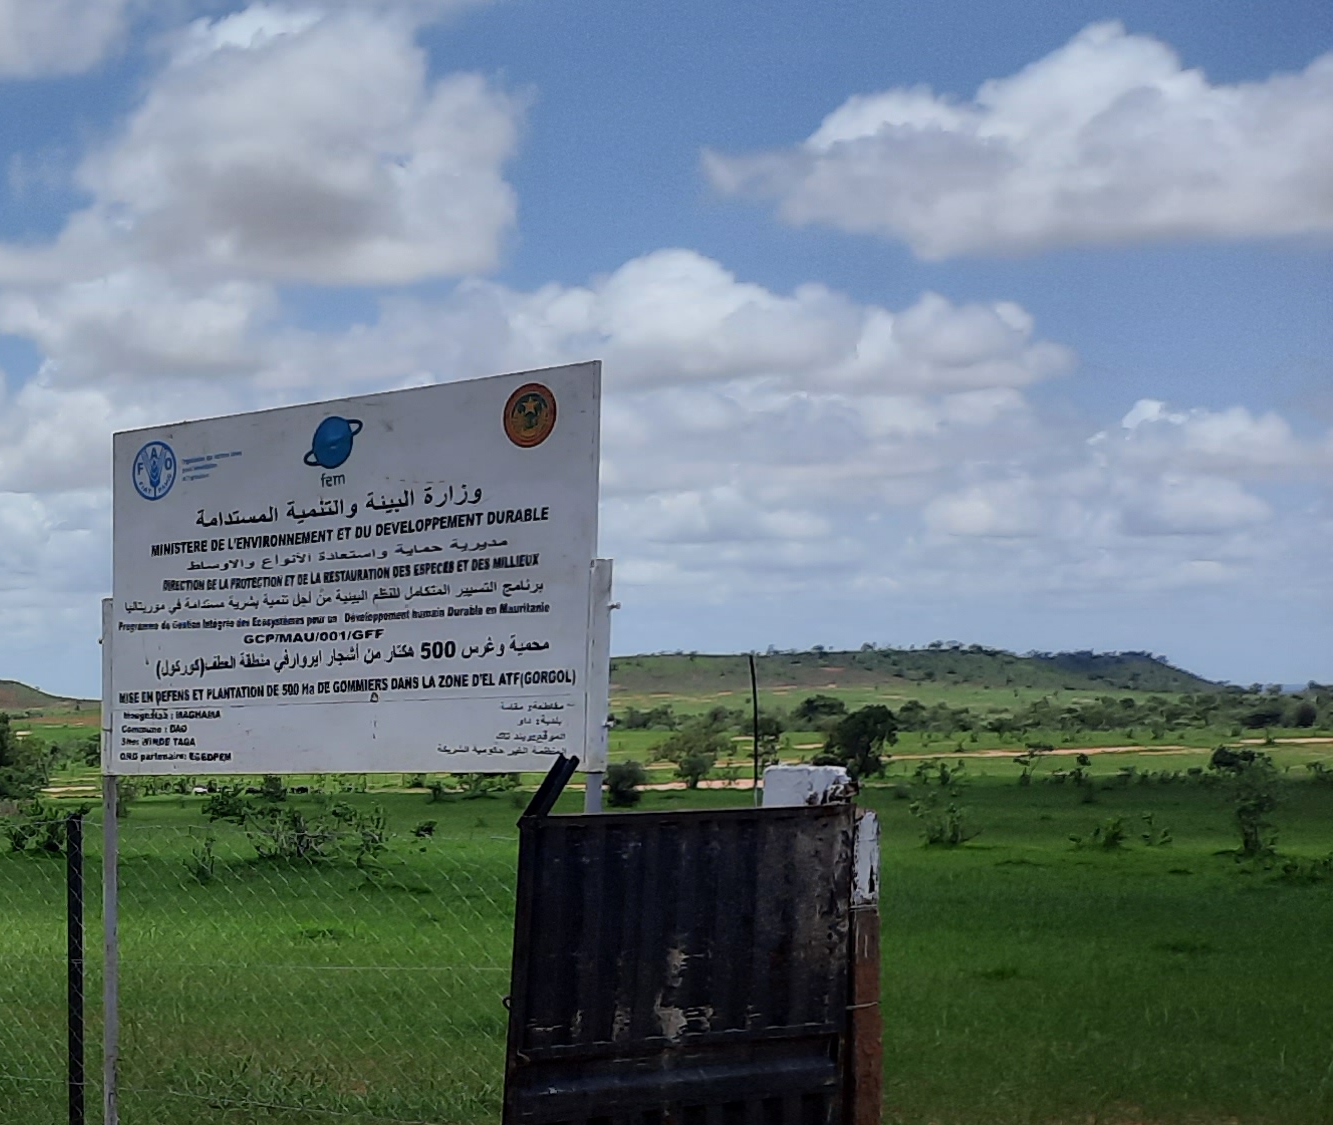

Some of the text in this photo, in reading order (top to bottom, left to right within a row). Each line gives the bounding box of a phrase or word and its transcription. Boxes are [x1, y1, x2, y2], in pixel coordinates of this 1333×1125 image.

[321, 473, 346, 488] fem
[424, 484, 482, 507] وزارة
[195, 506, 278, 527] المستدامة
[151, 506, 549, 557] MINISTERE DE L'ENVIRONNEMENT ET DU DEVELOPPEMENT DURABLE
[395, 544, 443, 557] حماية
[449, 538, 508, 551] مديرية
[162, 553, 540, 591] DIRECTION DE LA PROTECTION ET DE LA RESTAURATION DES ESPECES ET DES MILLIEUX
[502, 578, 543, 597] برنامج
[168, 599, 181, 615] في
[447, 605, 483, 617] Durable
[485, 605, 497, 615] en
[499, 602, 550, 614] Mauritanie
[243, 629, 384, 645] GCP/MAU/001/GFF
[509, 633, 550, 653] محمية
[363, 650, 381, 665] من
[420, 640, 456, 660] 500
[119, 691, 139, 705] MISE
[141, 690, 153, 703] EN
[155, 689, 190, 703] DEFENS
[192, 688, 204, 701] ET
[206, 685, 264, 700] PLANTATION
[266, 684, 279, 697] DE
[282, 683, 299, 695] 500
[302, 682, 315, 695] Ha
[317, 681, 330, 694] DE
[332, 678, 388, 694] GOMMIERS
[391, 675, 419, 690] DANS
[422, 674, 435, 689] LA
[438, 673, 469, 688] ZONE
[471, 672, 495, 687] D'EL
